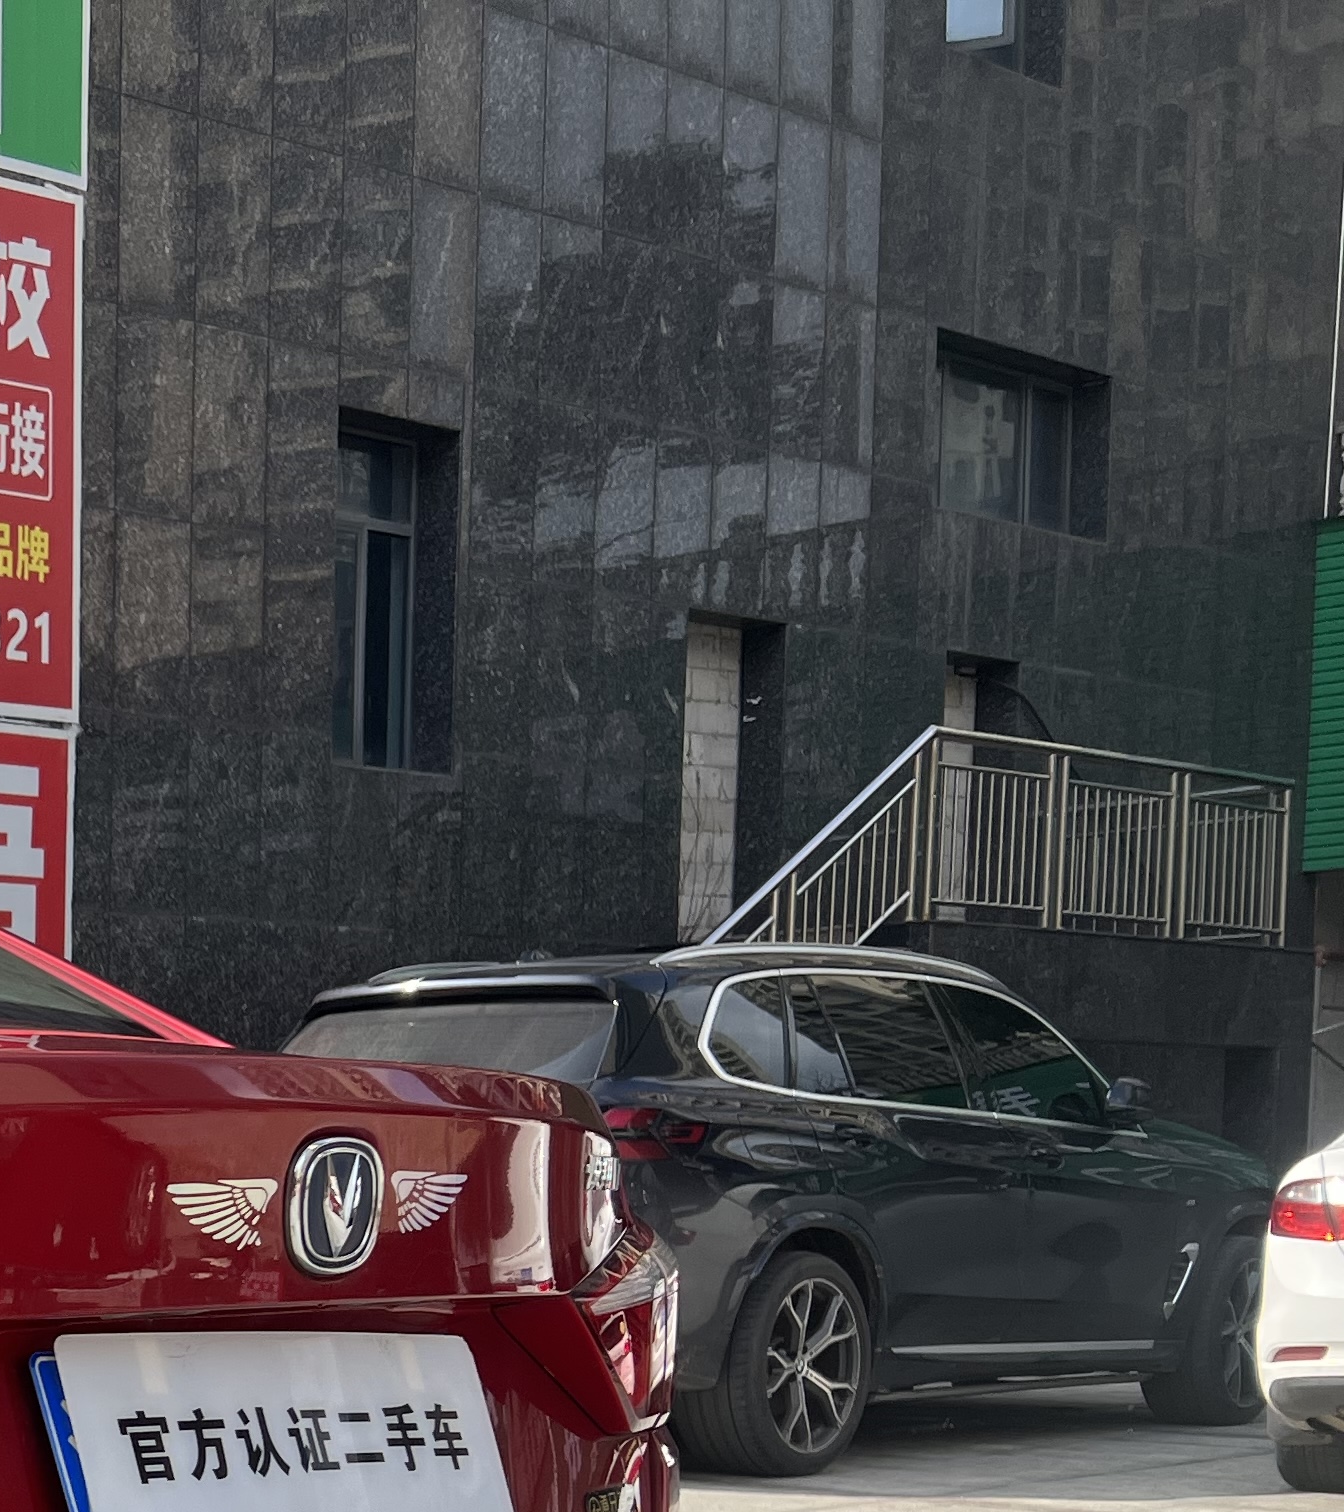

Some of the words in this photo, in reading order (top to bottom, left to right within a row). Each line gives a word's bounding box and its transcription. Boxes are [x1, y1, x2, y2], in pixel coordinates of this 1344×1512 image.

[117, 1402, 470, 1486] 官方认证二手车
